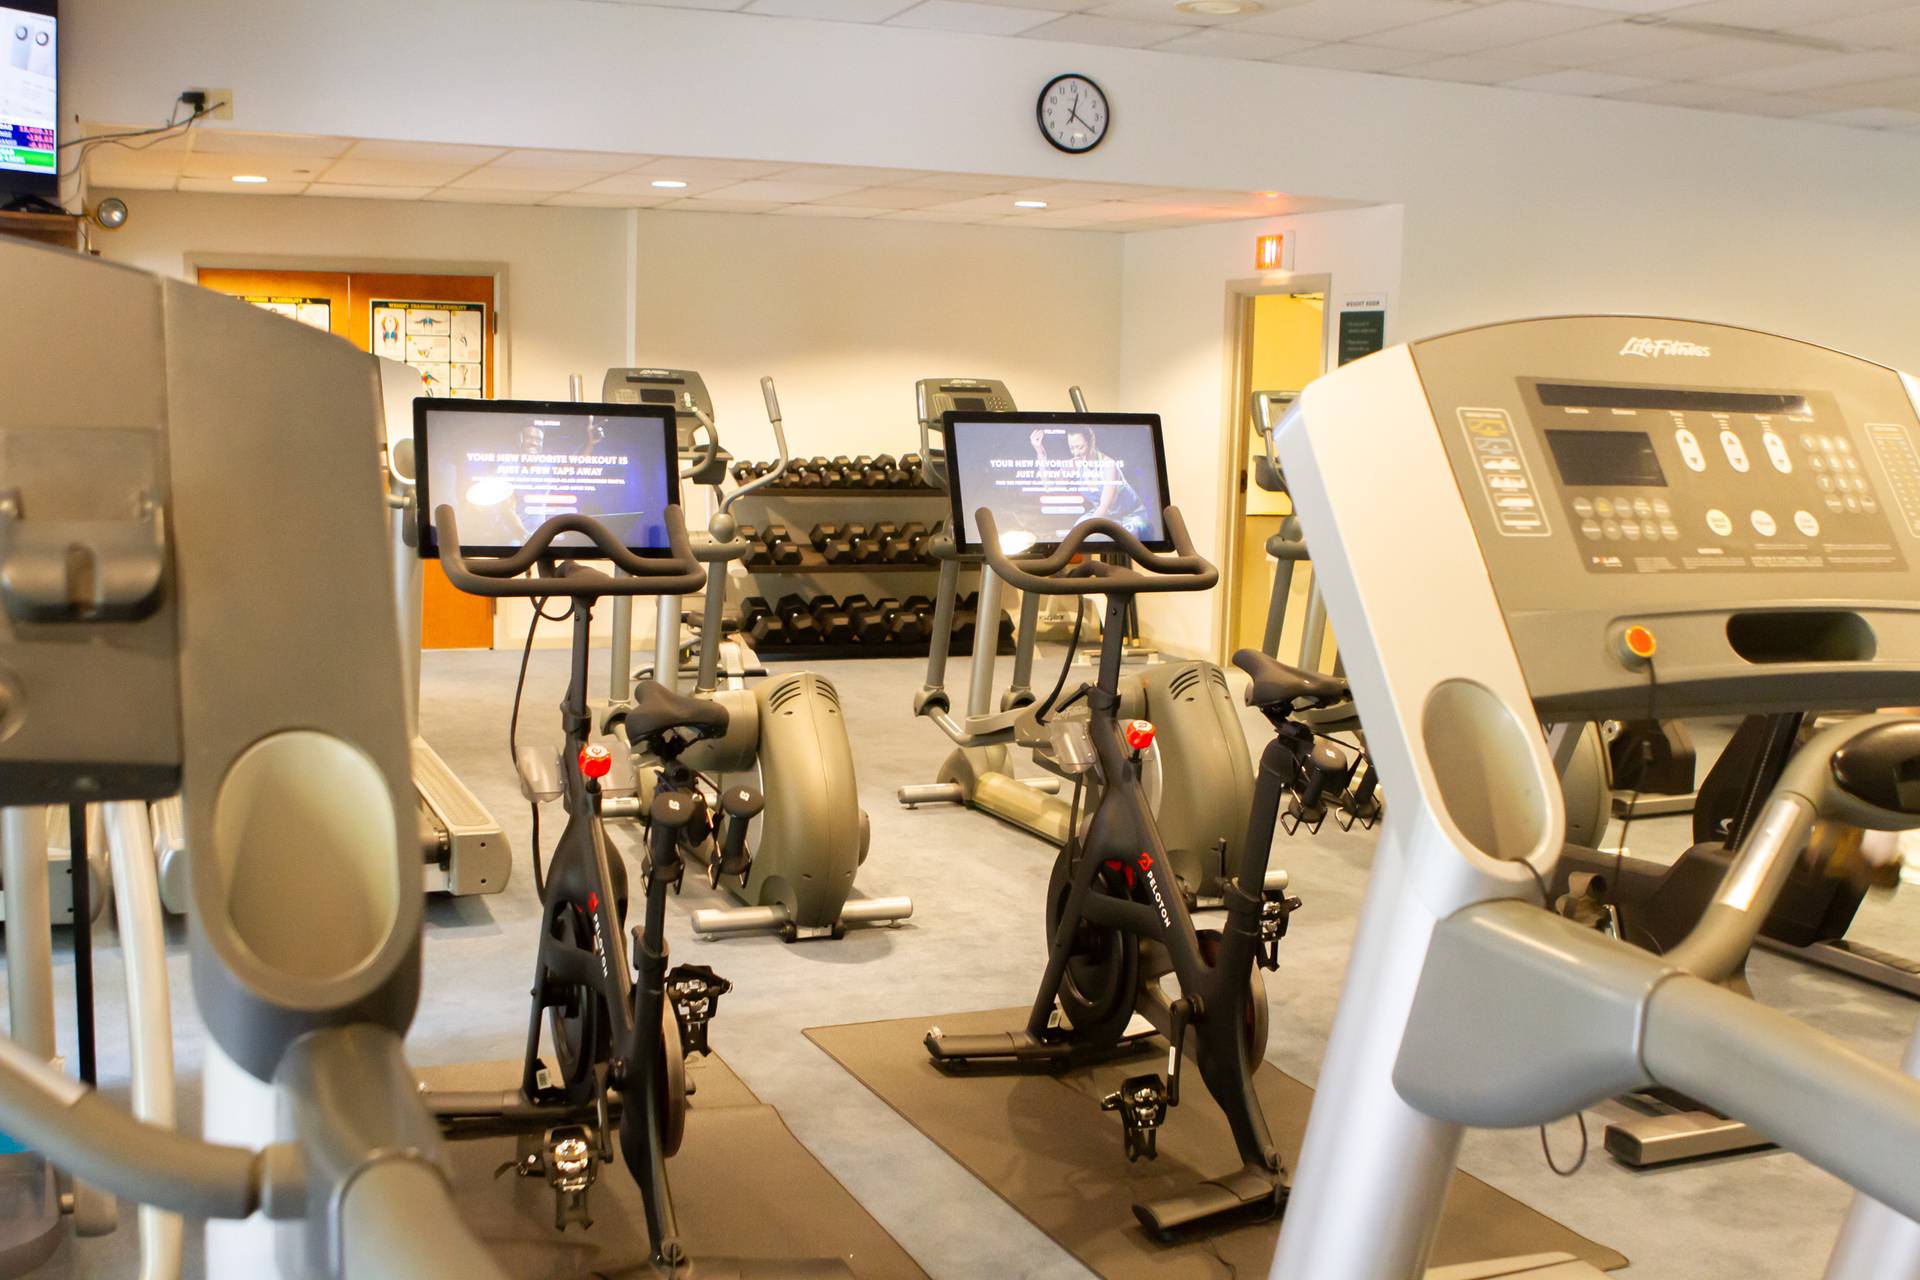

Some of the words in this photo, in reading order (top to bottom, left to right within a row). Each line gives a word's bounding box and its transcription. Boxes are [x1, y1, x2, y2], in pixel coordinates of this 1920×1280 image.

[466, 453, 495, 462] YOUR
[497, 453, 519, 463] NEW
[521, 454, 568, 464] FAVORITE
[569, 455, 617, 465] WORKOUT
[618, 456, 628, 465] IS
[990, 459, 1014, 468] YOUR
[1015, 459, 1034, 468] NEW
[1035, 459, 1074, 468] FAVORITE
[497, 466, 519, 475] JUST
[530, 466, 550, 475] FEW
[552, 466, 575, 476] TAPS
[576, 467, 603, 476] AWAY
[1016, 470, 1035, 478] JUST
[1147, 870, 1171, 928] PELOTON
[593, 912, 608, 978] PELOTON
